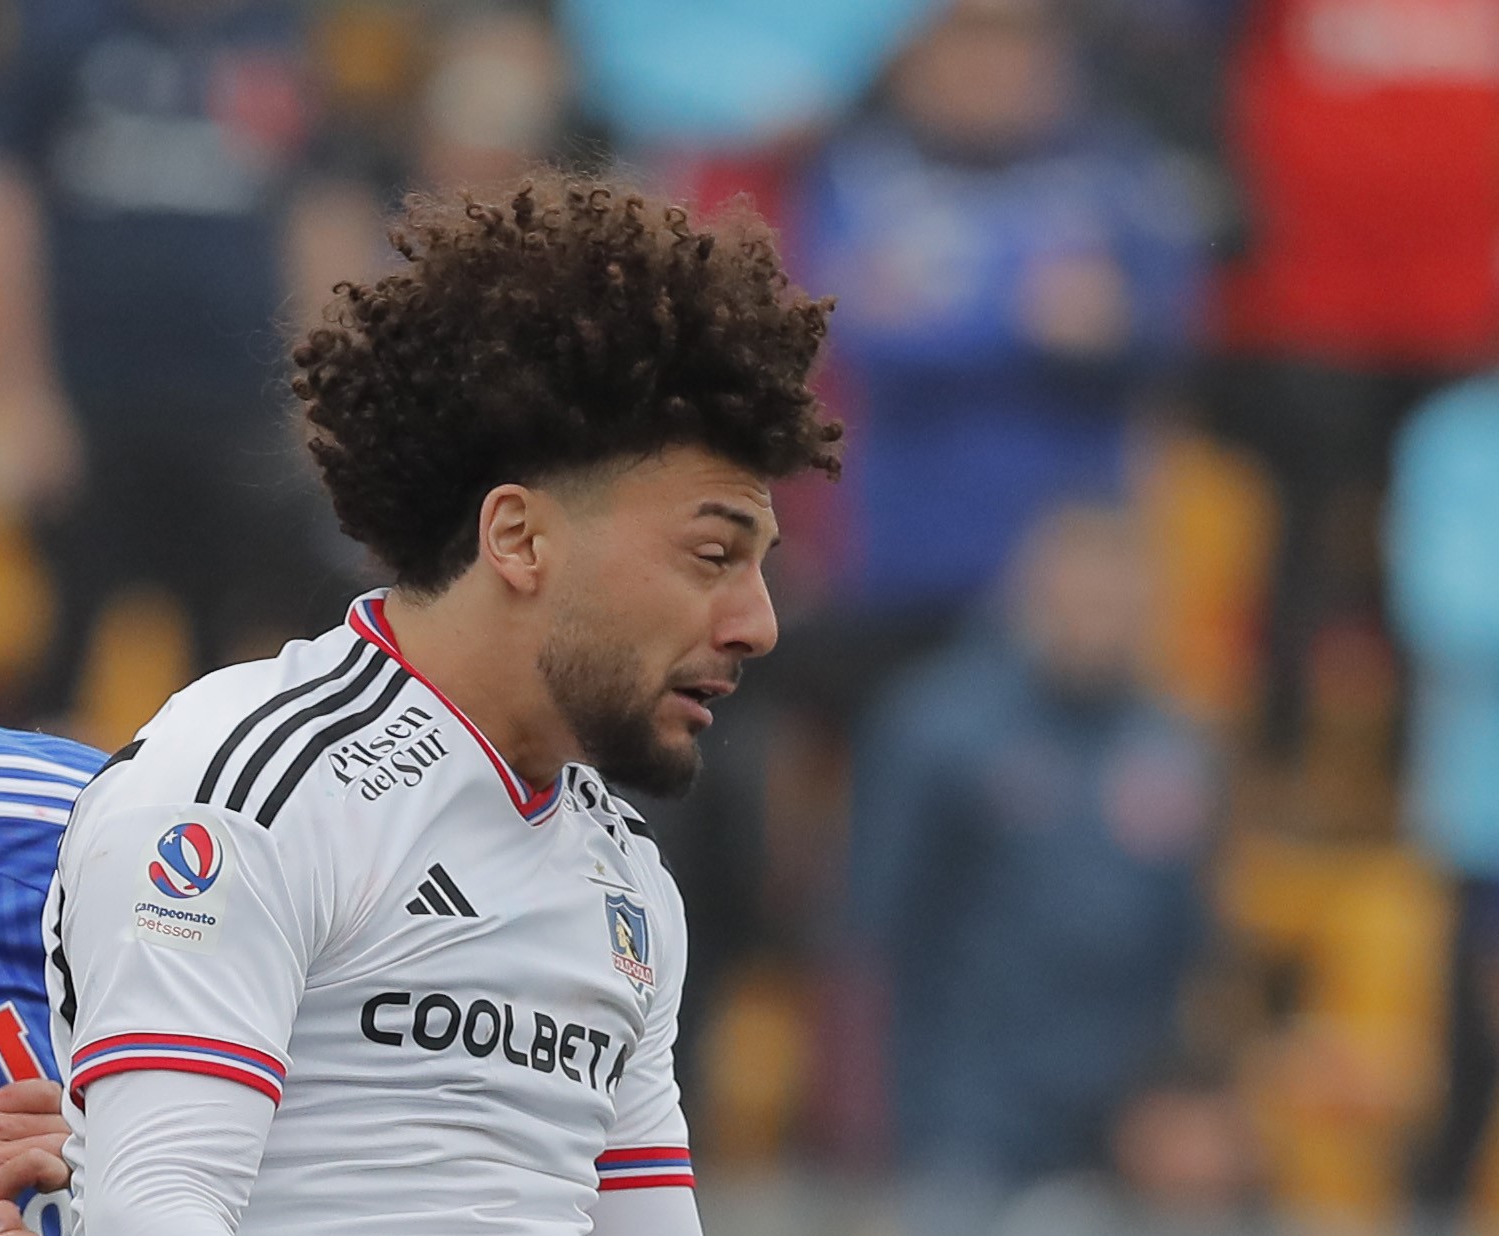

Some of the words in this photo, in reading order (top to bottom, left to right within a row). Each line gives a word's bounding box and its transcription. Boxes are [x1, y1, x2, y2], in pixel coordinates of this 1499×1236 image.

[328, 706, 433, 787] Pilsen
[361, 766, 398, 801] del
[390, 728, 449, 787] Sur
[136, 915, 202, 942] betsson
